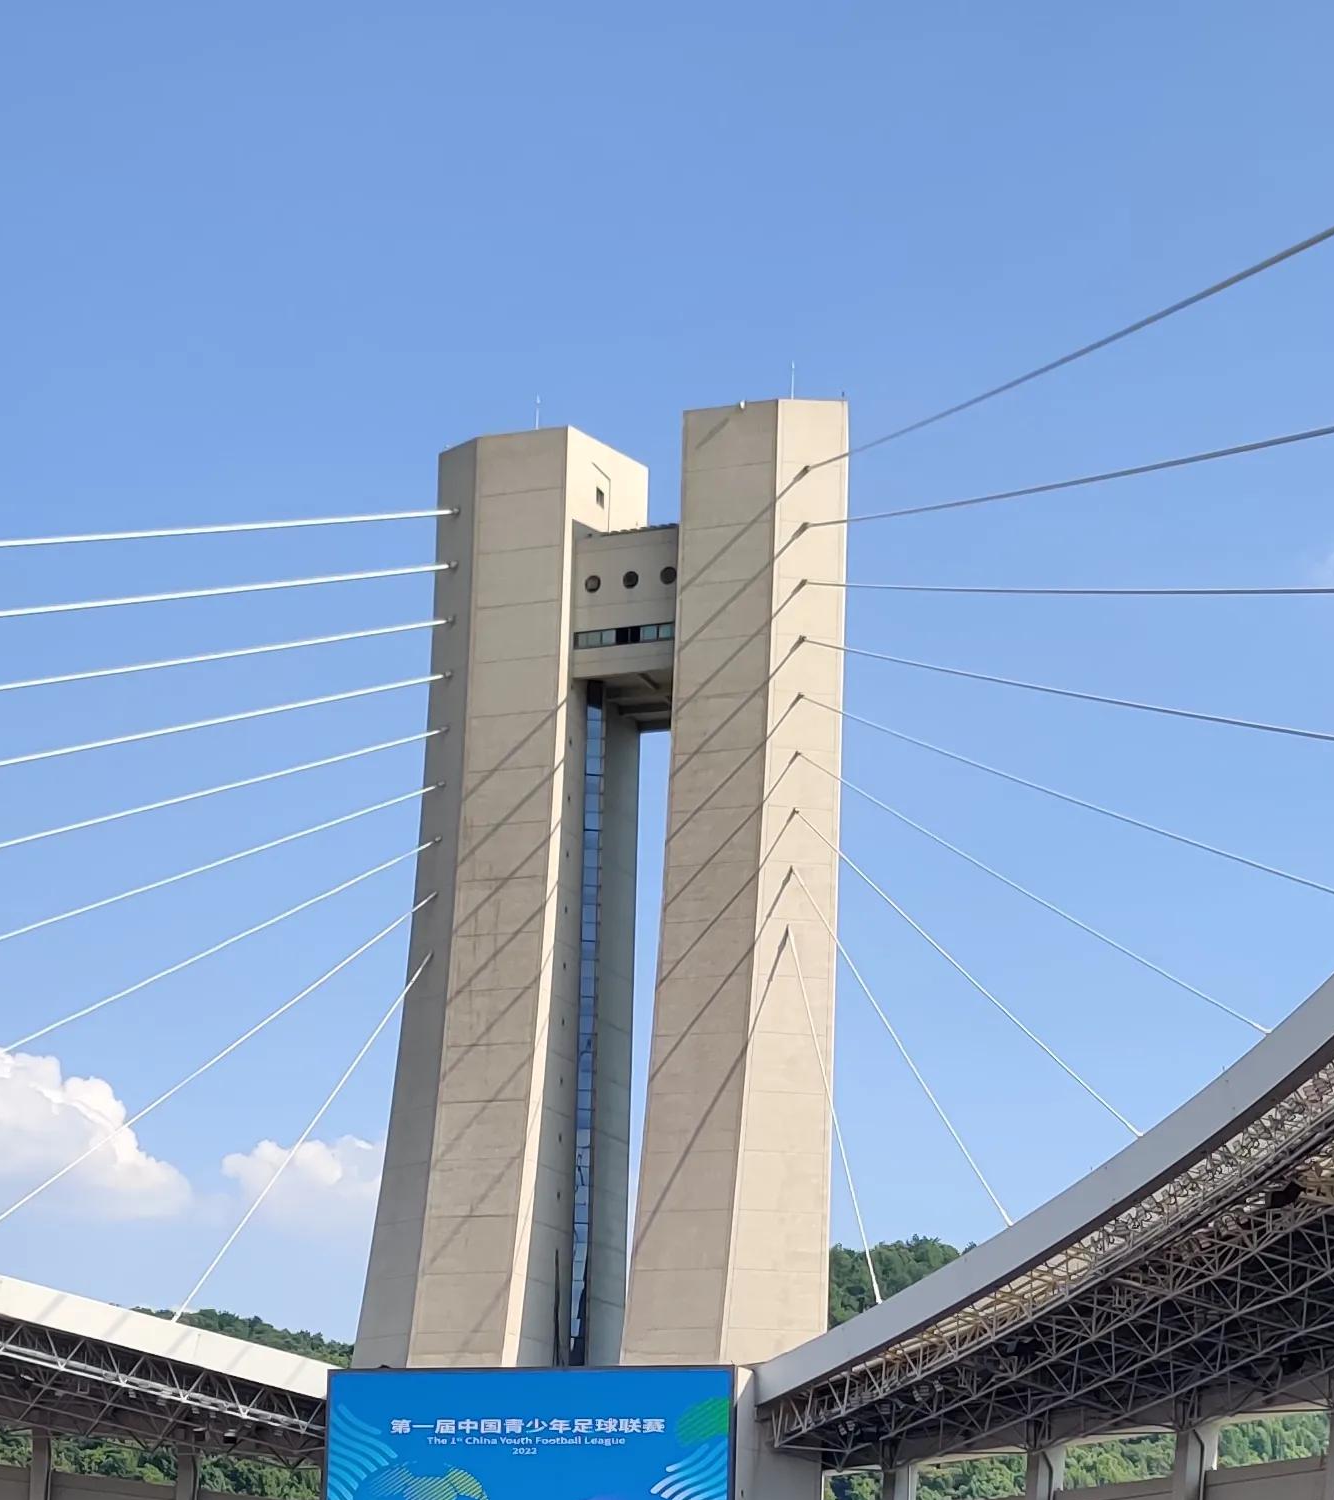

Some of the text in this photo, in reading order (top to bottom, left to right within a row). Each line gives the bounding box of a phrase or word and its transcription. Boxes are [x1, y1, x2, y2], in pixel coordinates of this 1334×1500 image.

[390, 1418, 666, 1434] 第一届中国青少年足球联赛
[427, 1436, 447, 1445] The
[465, 1436, 498, 1445] China
[499, 1436, 532, 1445] Youth
[535, 1436, 581, 1445] Football
[584, 1437, 626, 1447] League
[512, 1447, 537, 1455] 2022
